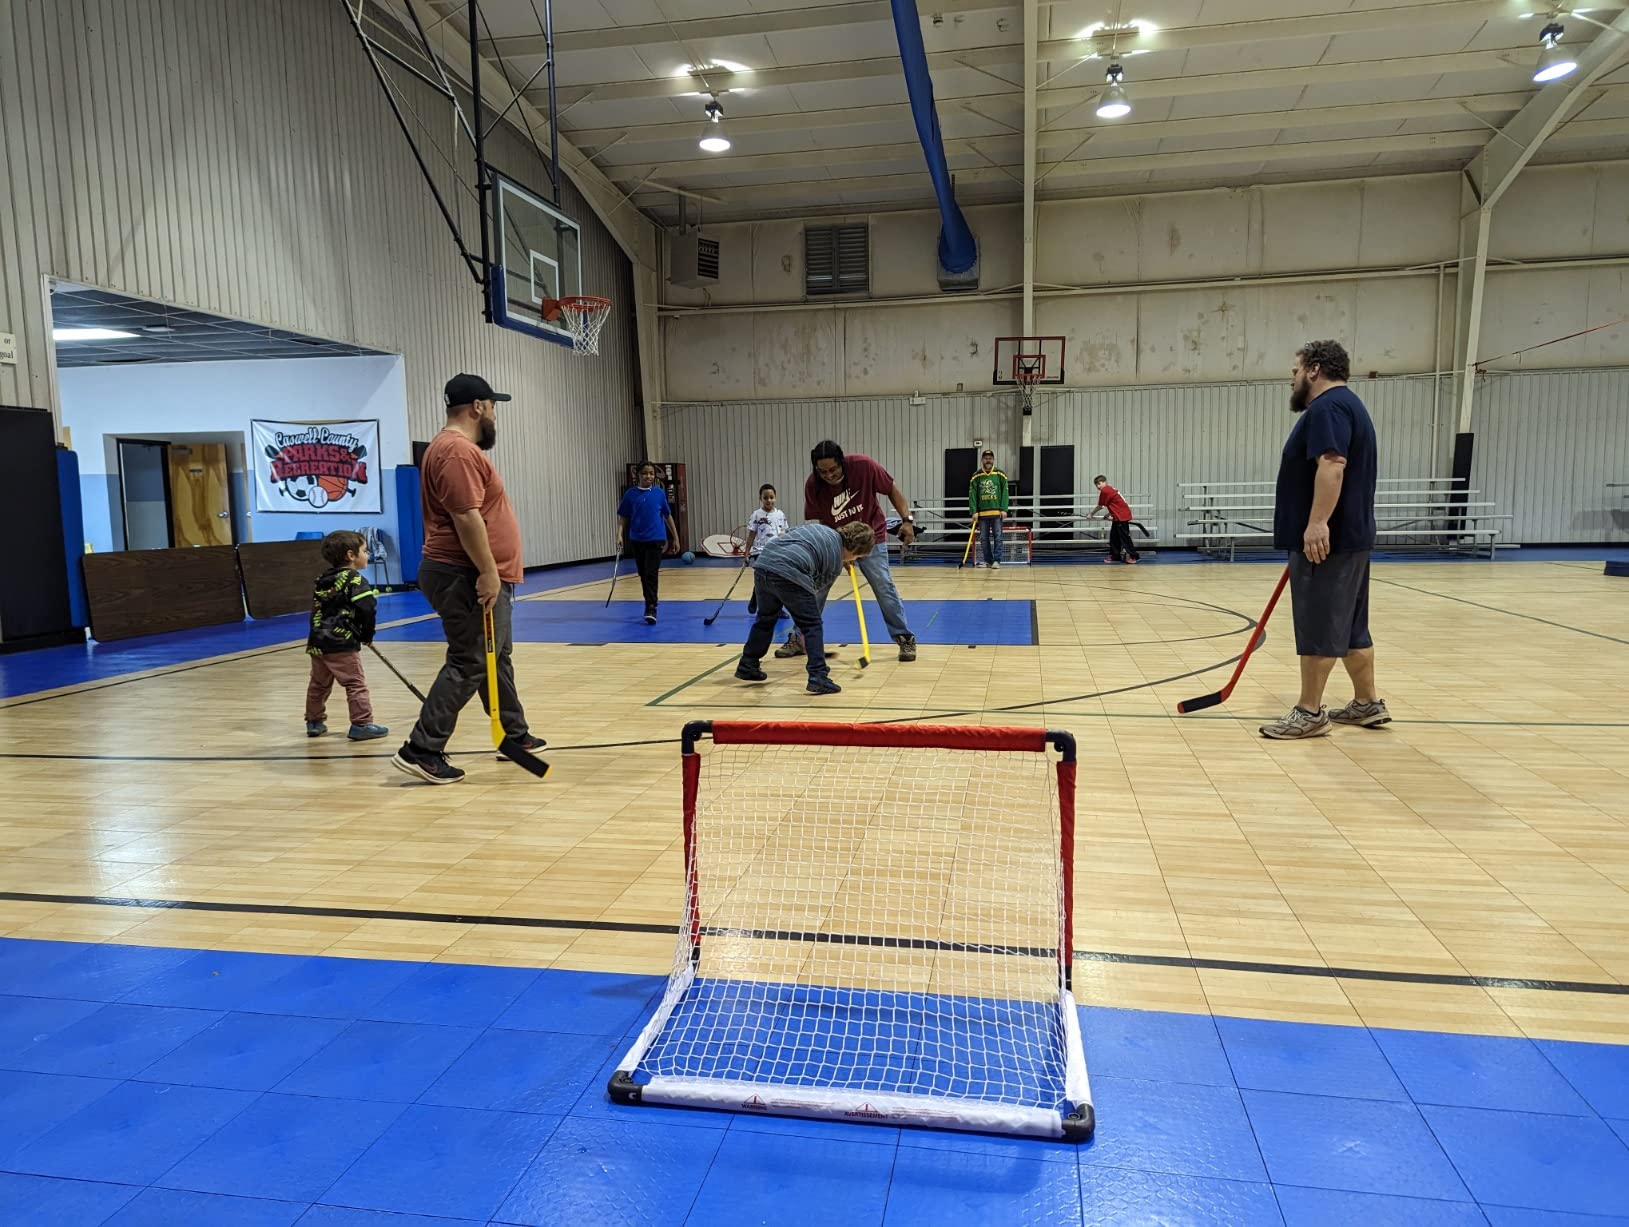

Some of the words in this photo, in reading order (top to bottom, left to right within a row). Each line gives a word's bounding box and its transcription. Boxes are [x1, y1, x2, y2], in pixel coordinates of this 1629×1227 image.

[275, 427, 319, 448] Caswell
[320, 427, 360, 452] County
[271, 460, 367, 483] RECREATION
[834, 510, 848, 523] JUST
[741, 1103, 768, 1111] WARNING
